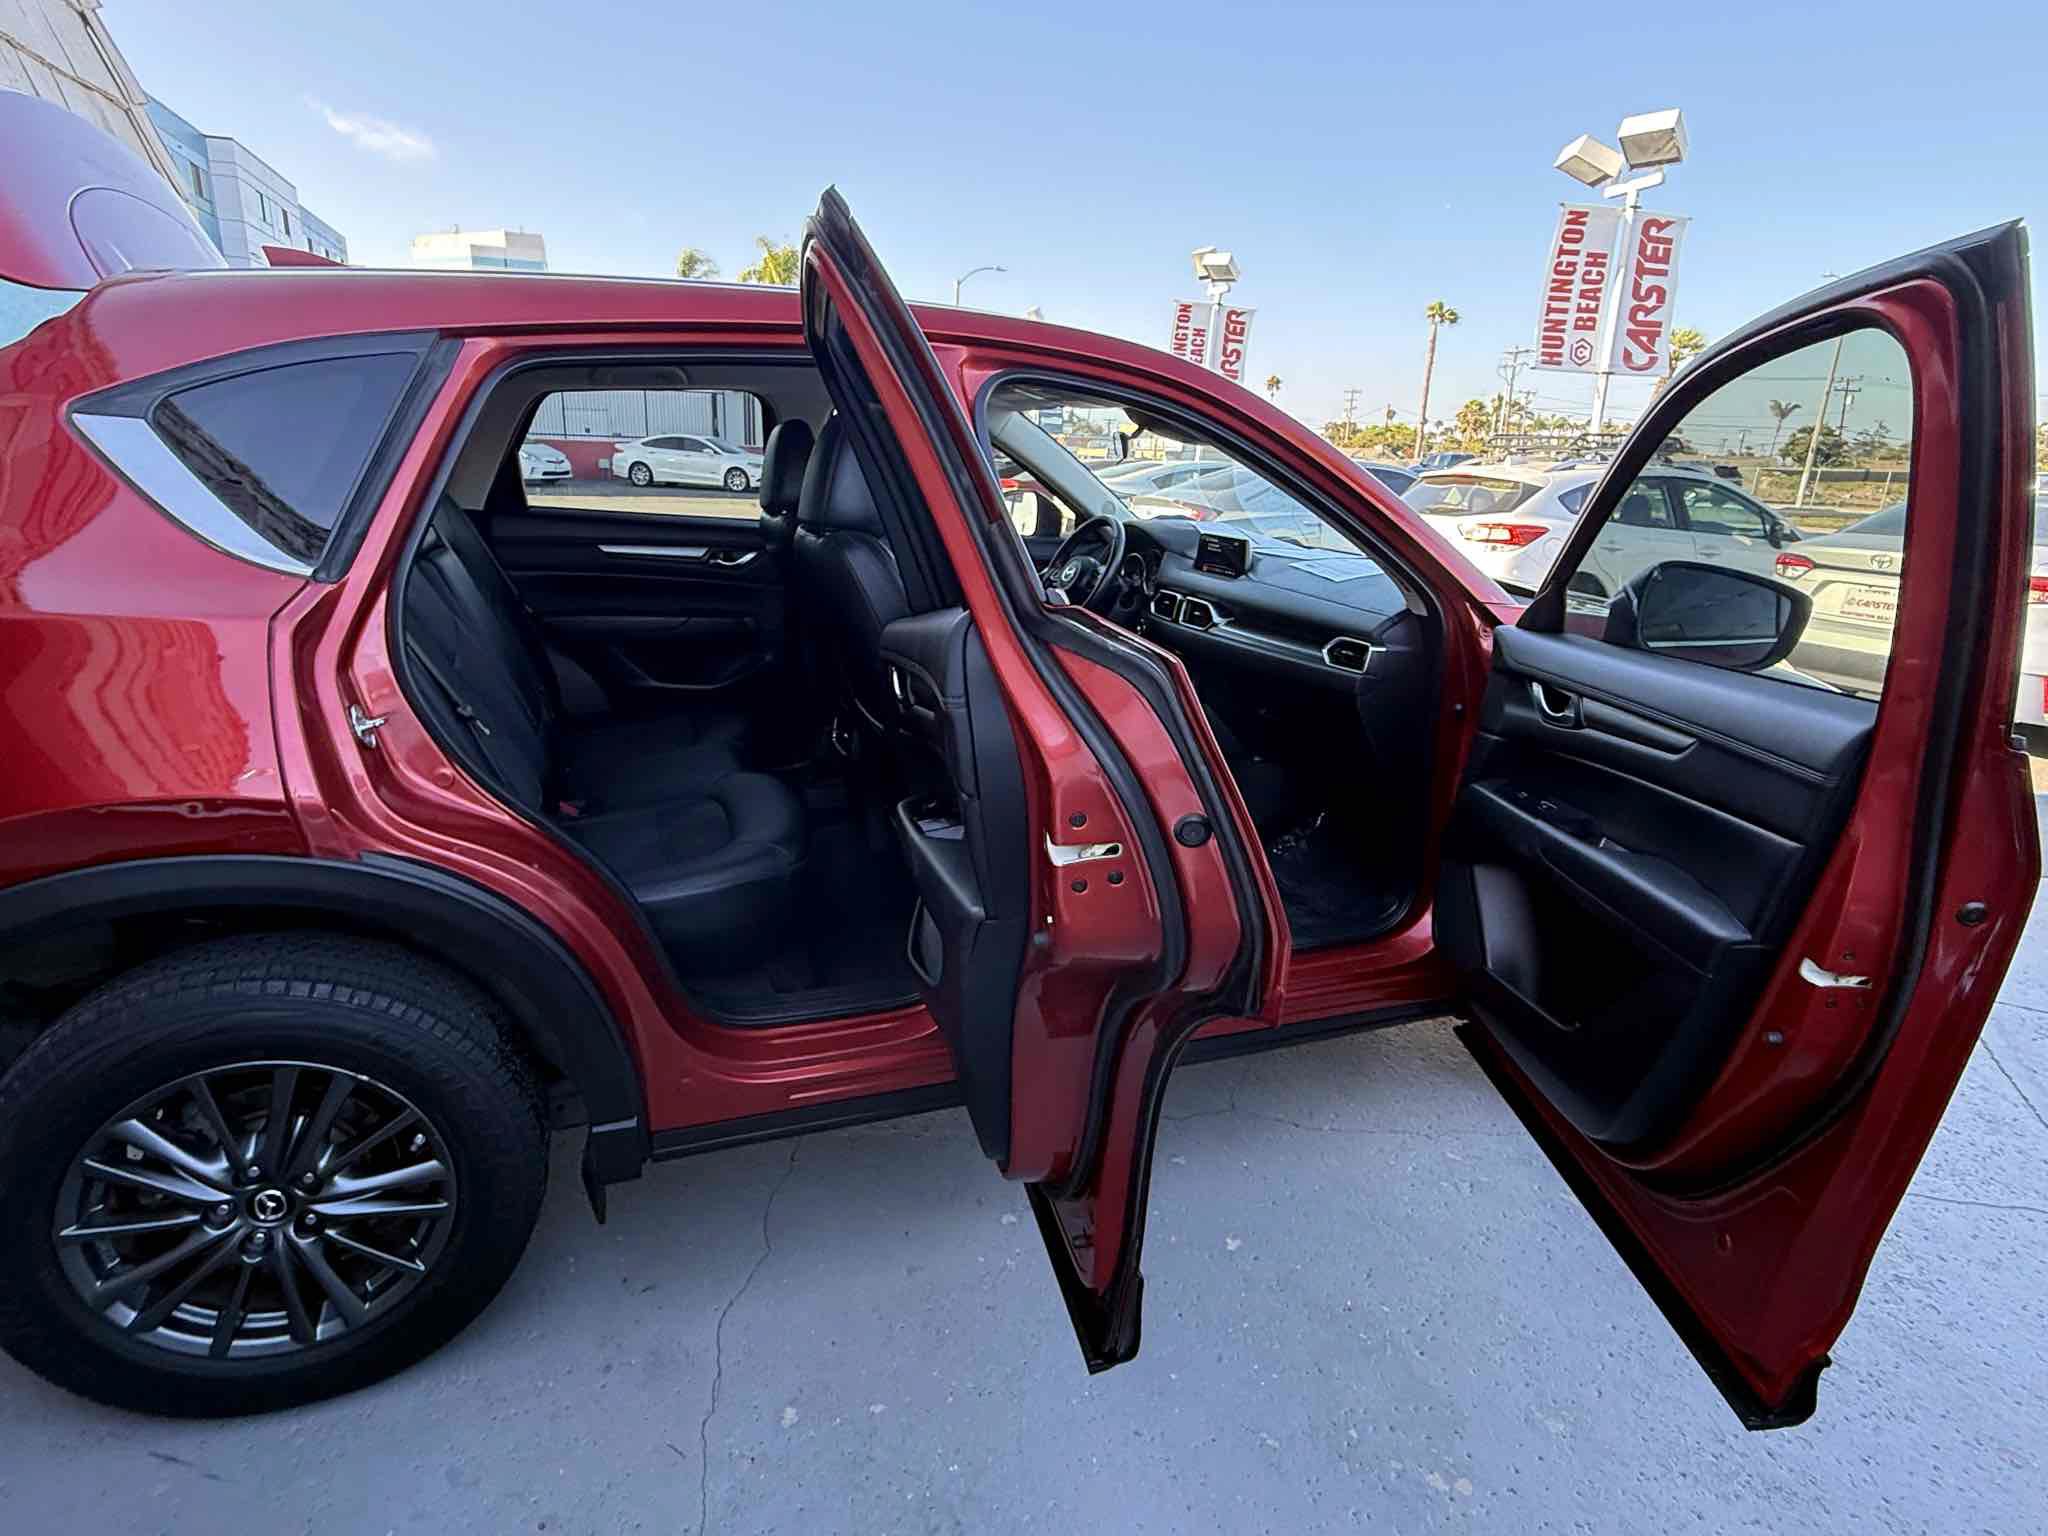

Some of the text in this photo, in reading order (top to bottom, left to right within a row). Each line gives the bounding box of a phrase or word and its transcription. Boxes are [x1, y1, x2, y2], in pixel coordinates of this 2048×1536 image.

[1541, 210, 1590, 366] HUNTINGTON
[1573, 251, 1609, 332] BEACH
[1622, 217, 1677, 371] CARSTER
[1173, 303, 1193, 356] INGTON
[1190, 327, 1207, 364] EACH
[1220, 309, 1248, 380] RSTER
